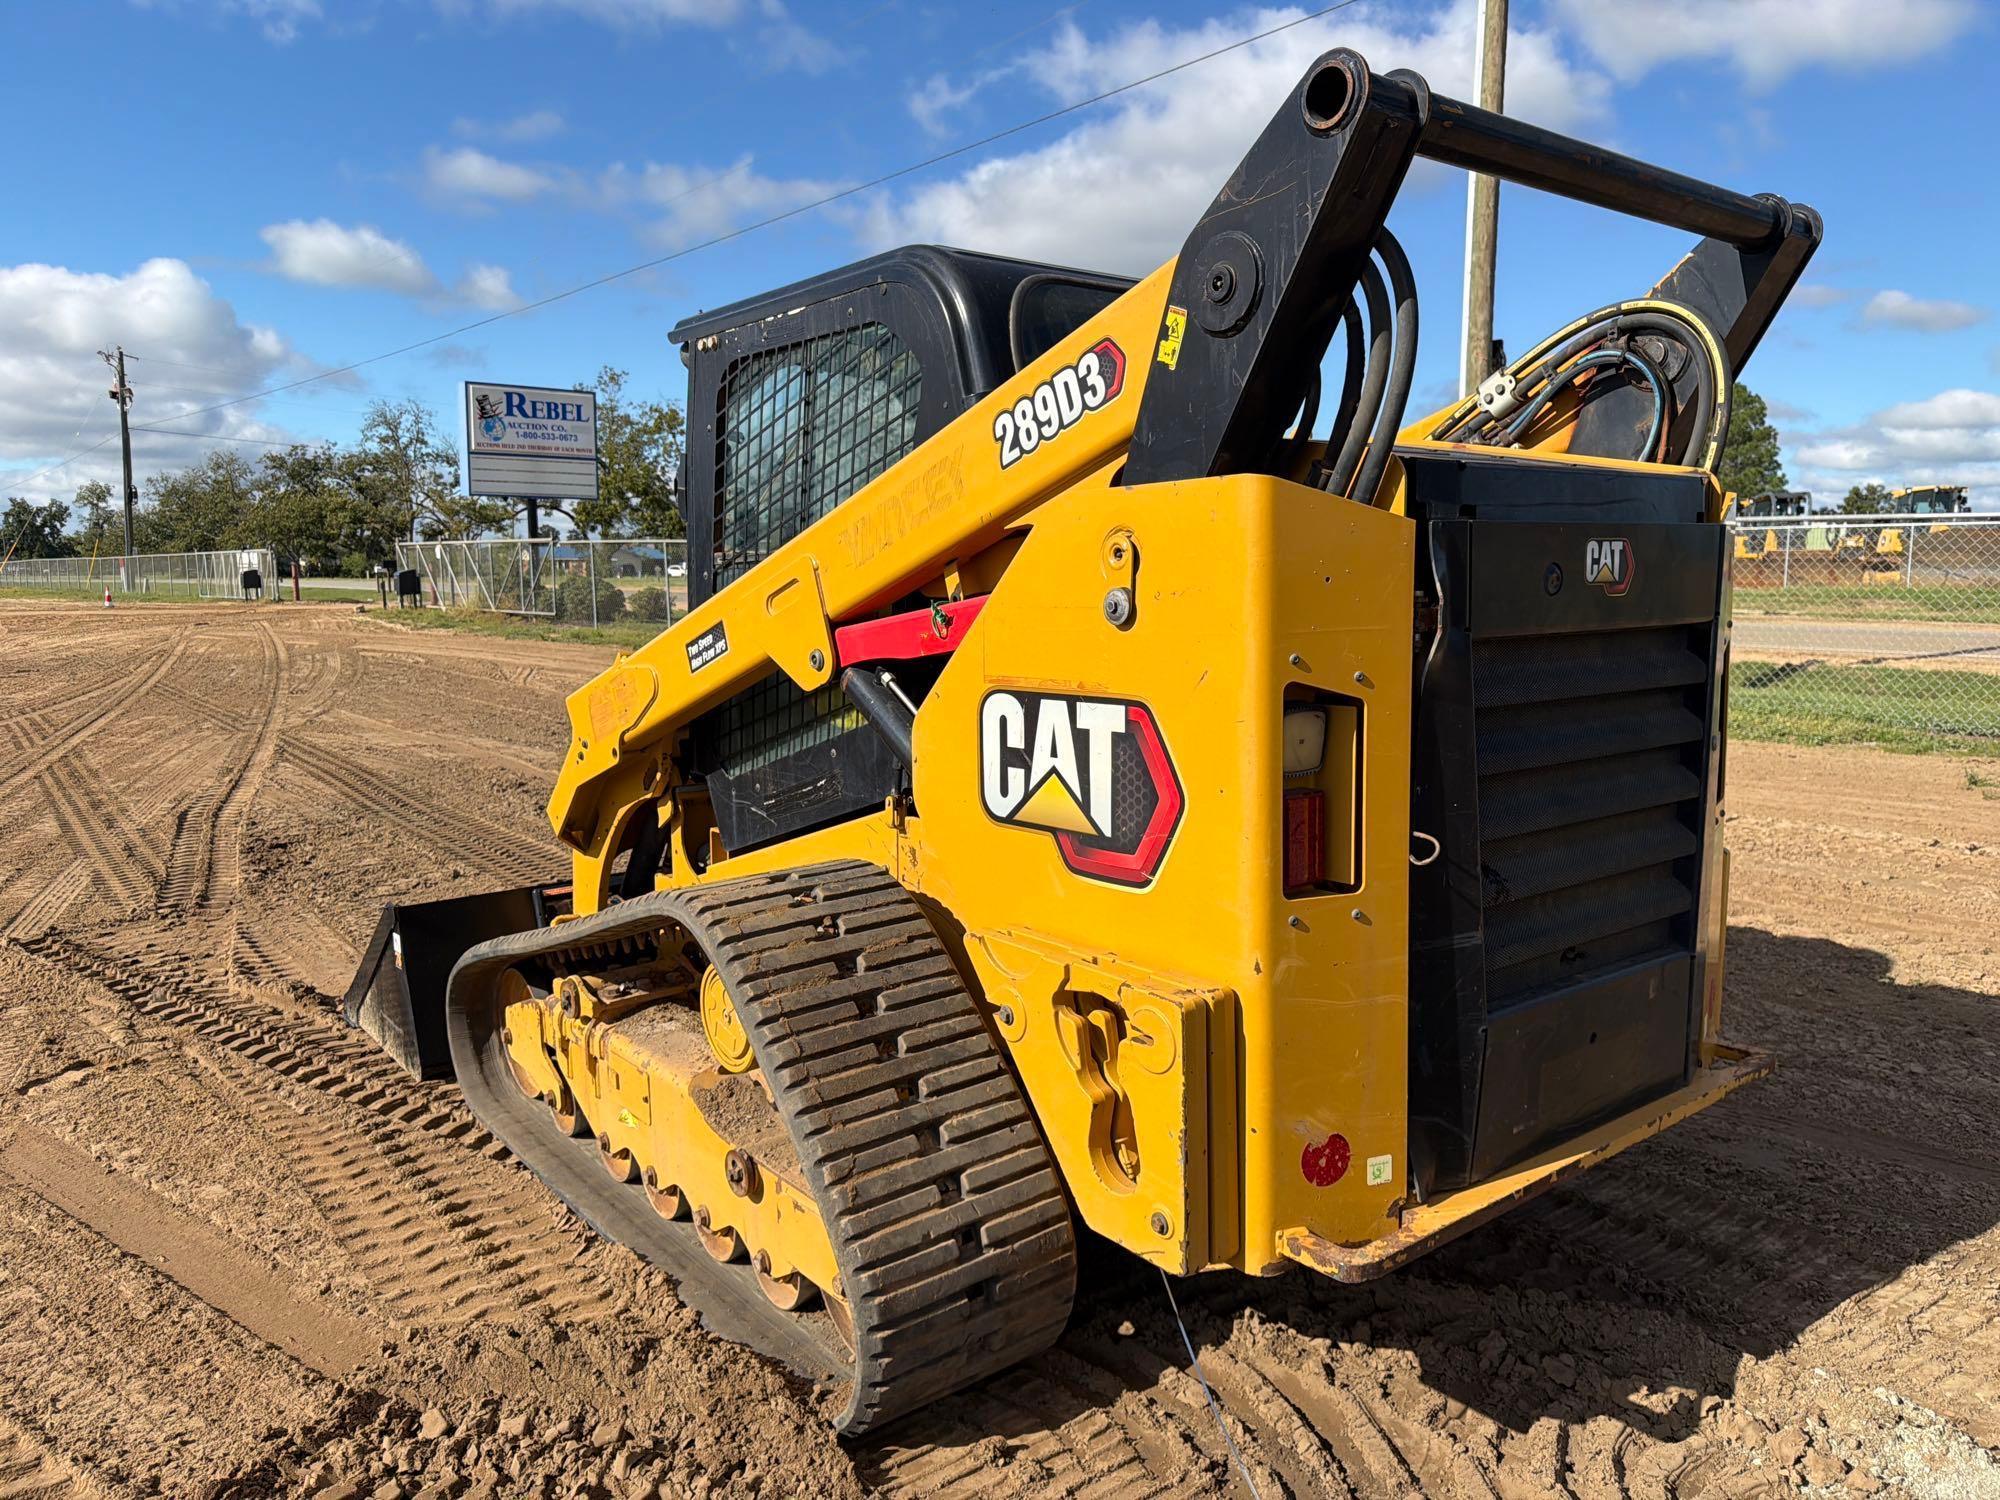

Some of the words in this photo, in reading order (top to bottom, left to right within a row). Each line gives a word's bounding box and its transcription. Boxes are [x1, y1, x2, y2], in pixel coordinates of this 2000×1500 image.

[504, 392, 590, 422] REBEL
[994, 352, 1106, 466] 289D3
[508, 422, 548, 431] AUCTION
[551, 424, 567, 432] CO.
[516, 432, 578, 442] 1-800-533-0673
[1586, 540, 1623, 583] CAT
[982, 692, 1126, 838] CAT
